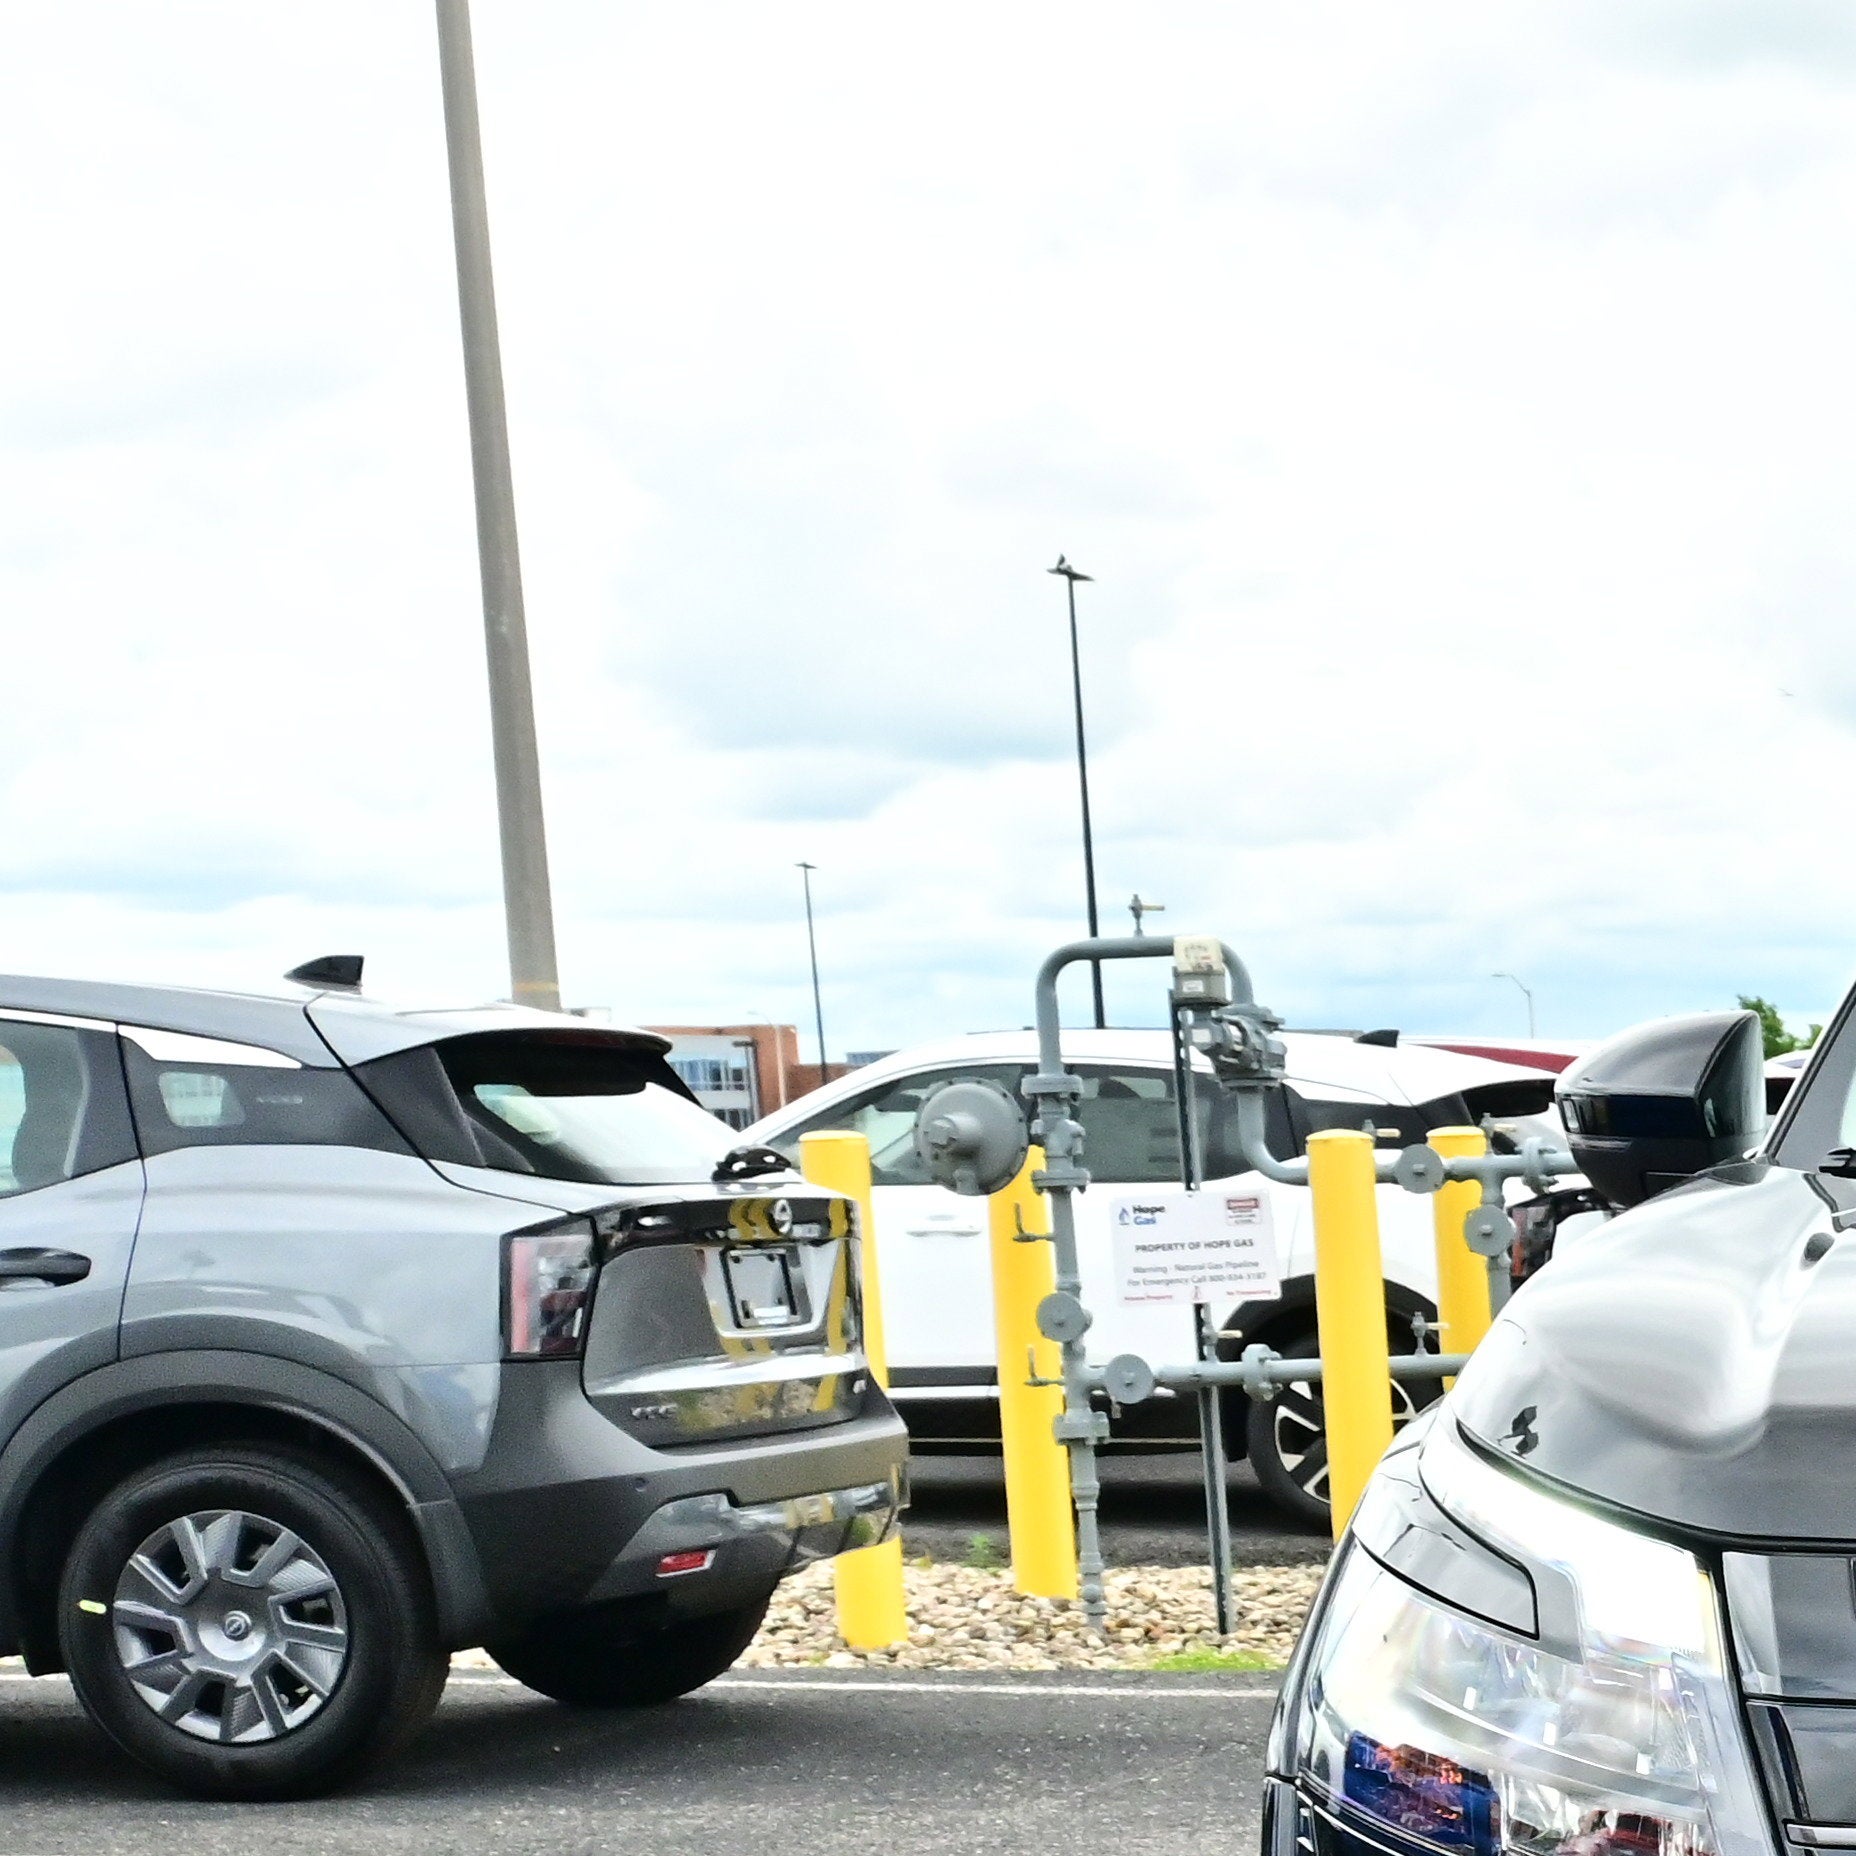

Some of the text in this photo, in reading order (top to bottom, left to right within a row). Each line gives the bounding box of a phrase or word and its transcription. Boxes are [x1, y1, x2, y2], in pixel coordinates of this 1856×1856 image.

[1132, 1204, 1166, 1214] Hope
[1133, 1216, 1157, 1226] Gas
[1135, 1238, 1254, 1253] PROPERTY OF HOPE GAS
